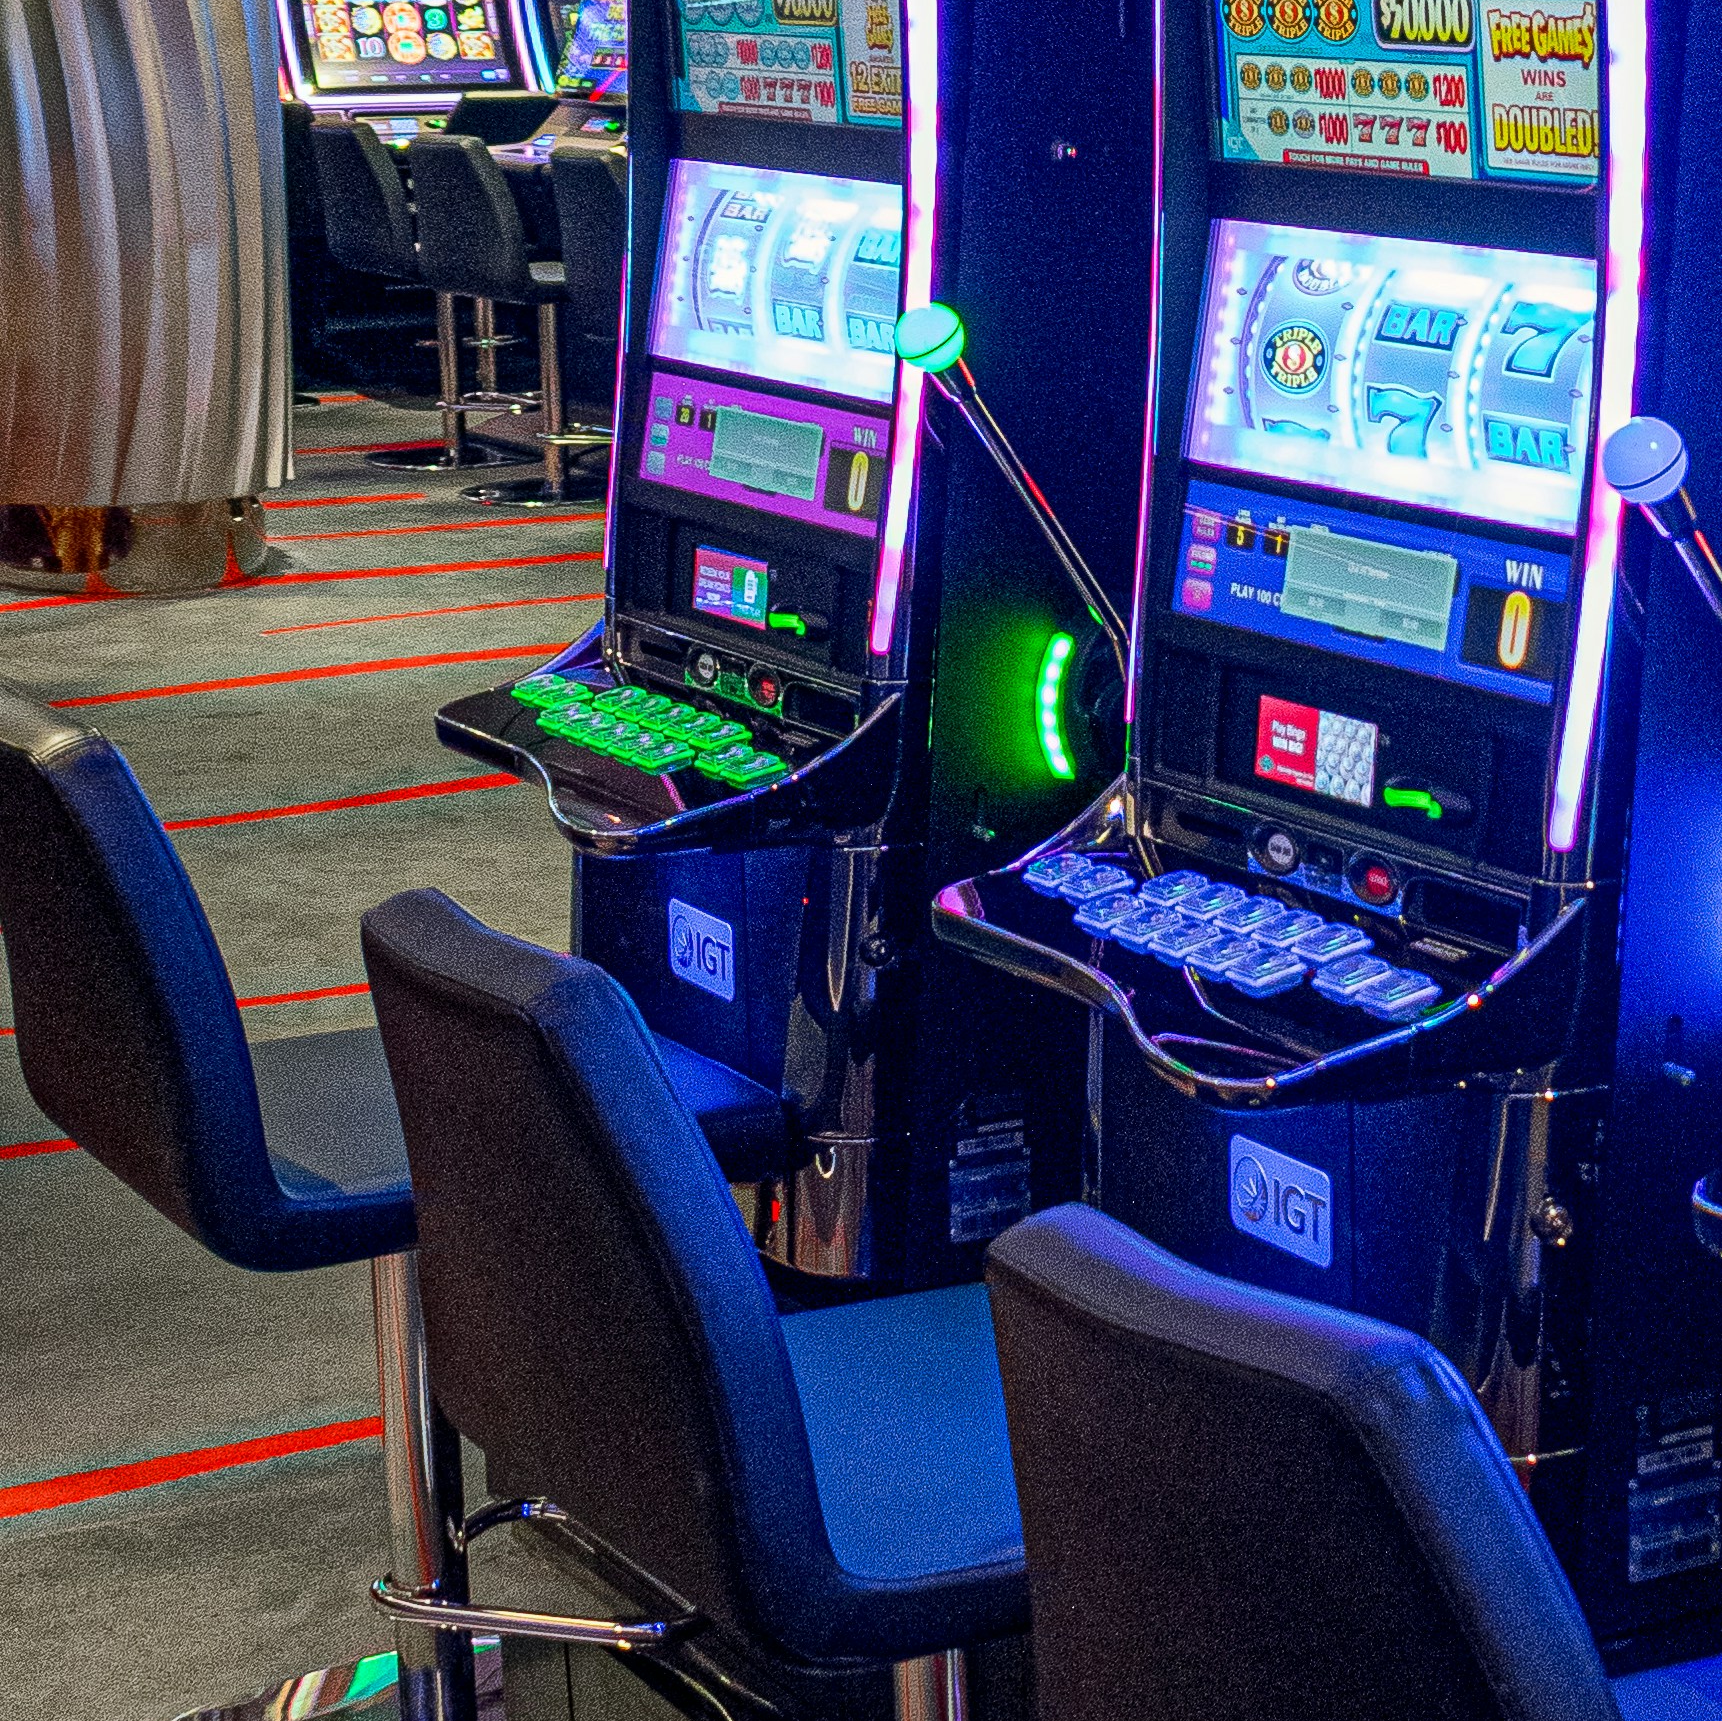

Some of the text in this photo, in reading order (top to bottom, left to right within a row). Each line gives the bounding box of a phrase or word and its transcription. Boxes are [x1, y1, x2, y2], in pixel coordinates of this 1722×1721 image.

[1228, 16, 1264, 37] TRIPLE
[1272, 18, 1309, 39] TRIPLE
[1317, 19, 1355, 41] TRIPLE
[1487, 9, 1531, 62] FREE
[356, 36, 386, 58] 10
[1521, 69, 1567, 88] WINS
[1534, 91, 1554, 102] ARE
[1353, 113, 1467, 154] 7 7 7 $100
[724, 202, 768, 221] BAR
[775, 305, 822, 339] BAR
[850, 319, 895, 352] BAR
[1382, 304, 1459, 347] BAR
[1272, 327, 1323, 355] TRIPLE
[1502, 302, 1596, 379] 7
[1271, 360, 1319, 388] TRIPLE
[1367, 386, 1443, 457] 7
[853, 427, 877, 449] WIN
[1487, 420, 1566, 469] BAR
[848, 451, 869, 512] 0
[1505, 559, 1544, 591] WIN
[1231, 582, 1254, 599] PLAY
[1257, 589, 1272, 605] 100
[1499, 590, 1533, 670] 0
[696, 930, 731, 982] IGT
[1273, 1177, 1326, 1244] IGT
